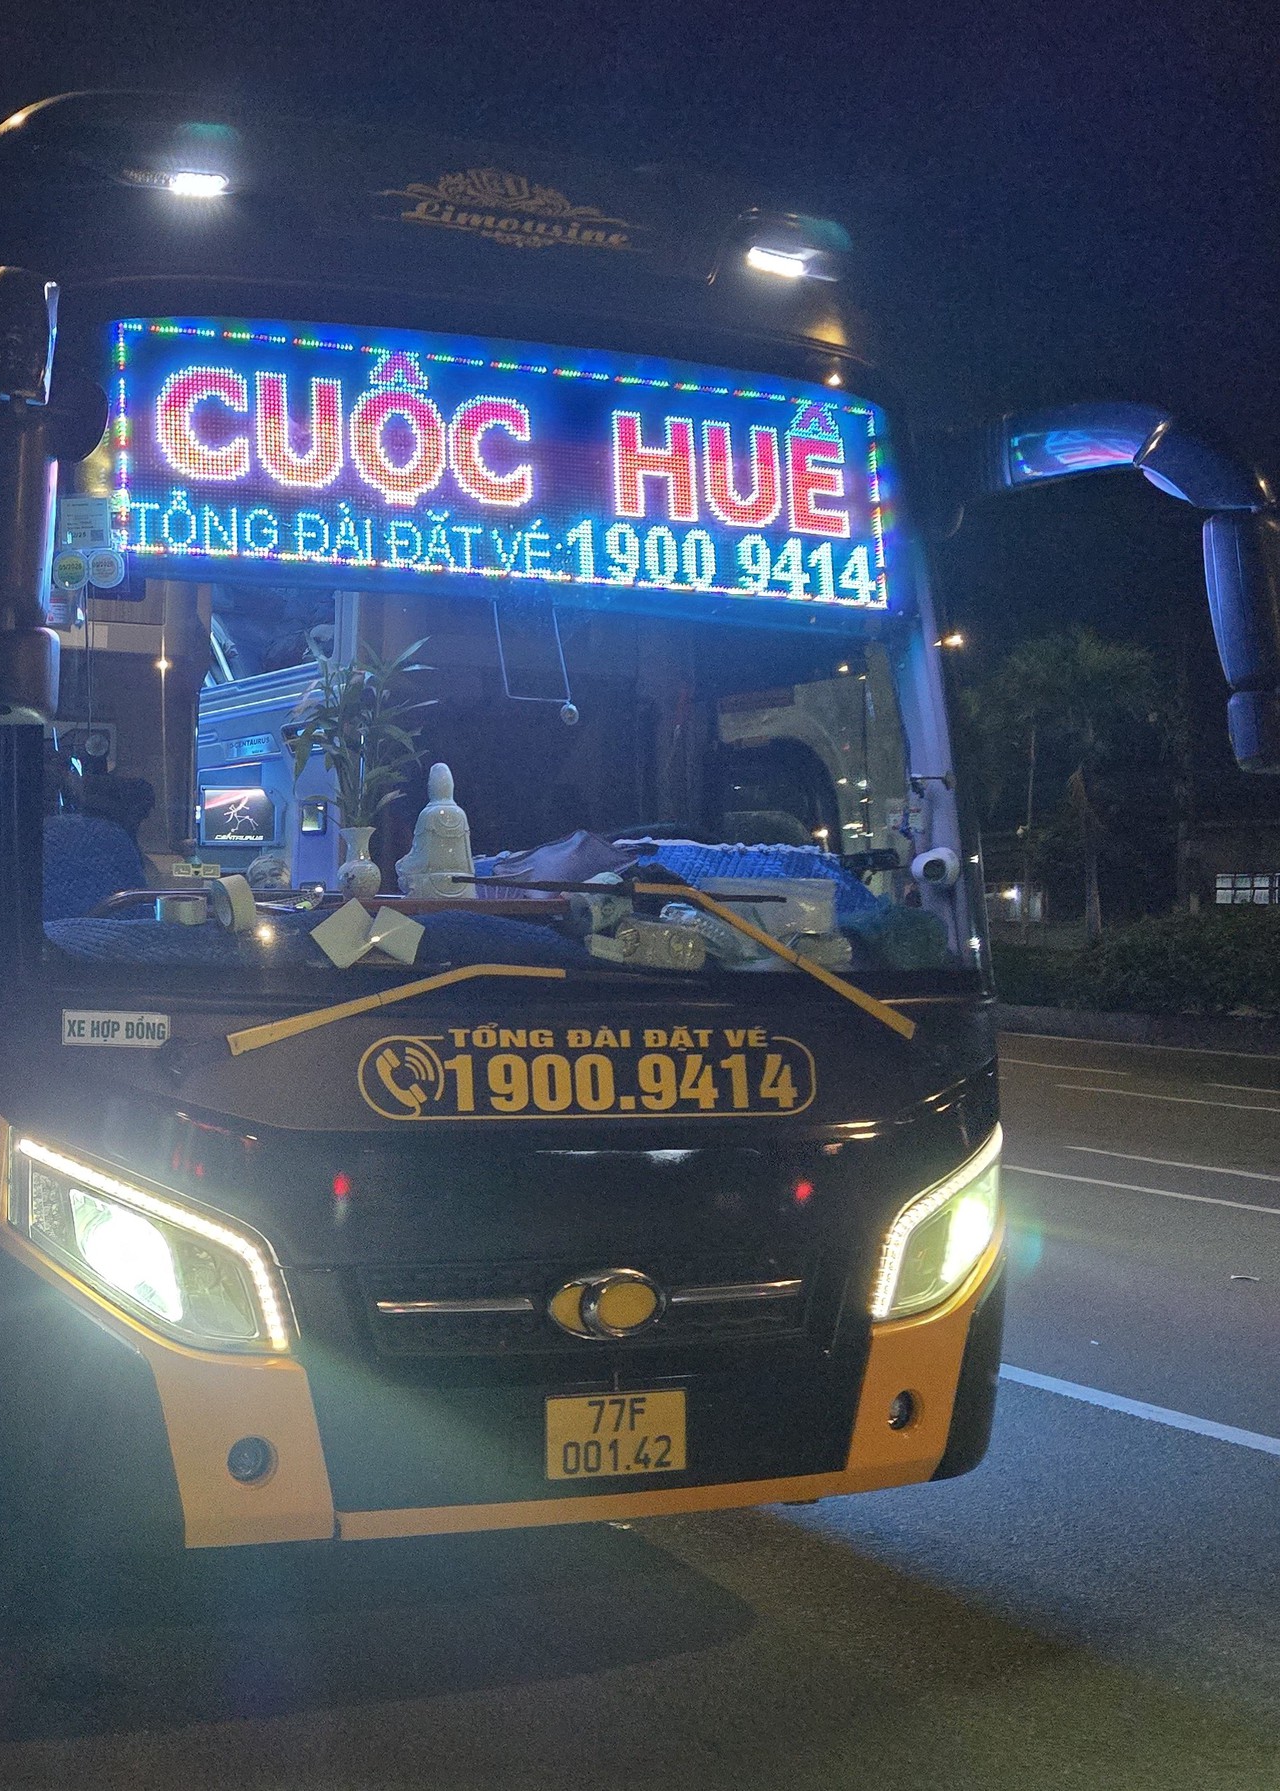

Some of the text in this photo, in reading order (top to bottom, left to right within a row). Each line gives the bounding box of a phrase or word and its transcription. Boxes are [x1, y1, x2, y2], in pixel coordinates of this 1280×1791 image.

[401, 201, 629, 246] Limousine
[155, 348, 534, 508] CUỘC
[293, 502, 376, 565] ĐÀI
[567, 519, 717, 591] 1900
[735, 533, 876, 605] 9414
[67, 1019, 85, 1037] XE
[91, 1019, 120, 1042] HỢP
[448, 1022, 768, 1052] TỔNG ĐÀI ĐẶT VÉ
[444, 1053, 798, 1112] 1900.9414
[588, 1397, 647, 1434] 77F
[562, 1434, 673, 1475] 001.42
